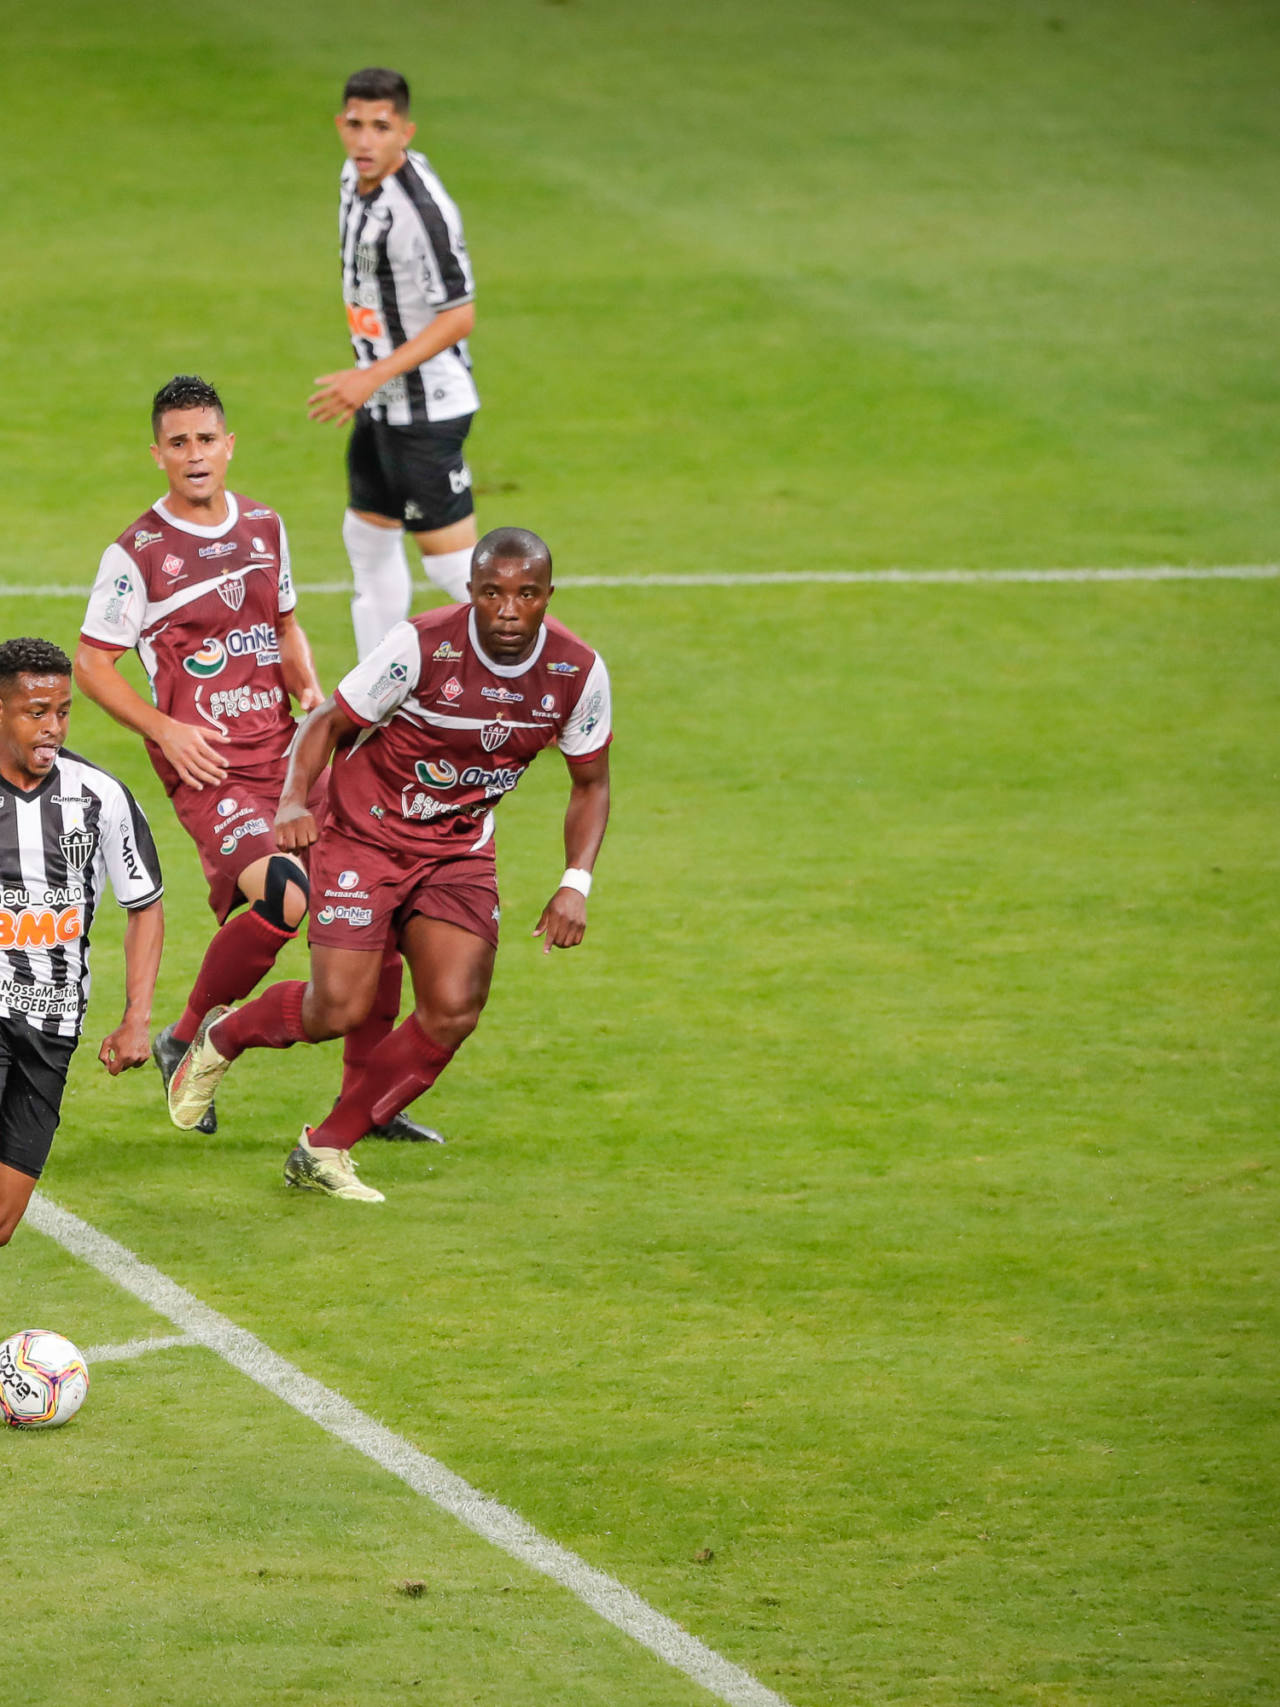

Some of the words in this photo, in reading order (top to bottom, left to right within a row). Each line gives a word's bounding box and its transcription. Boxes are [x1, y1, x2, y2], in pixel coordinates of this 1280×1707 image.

[229, 624, 278, 653] OnNe
[64, 835, 90, 845] CAM
[122, 835, 144, 879] MRV
[335, 906, 371, 919] OnNet
